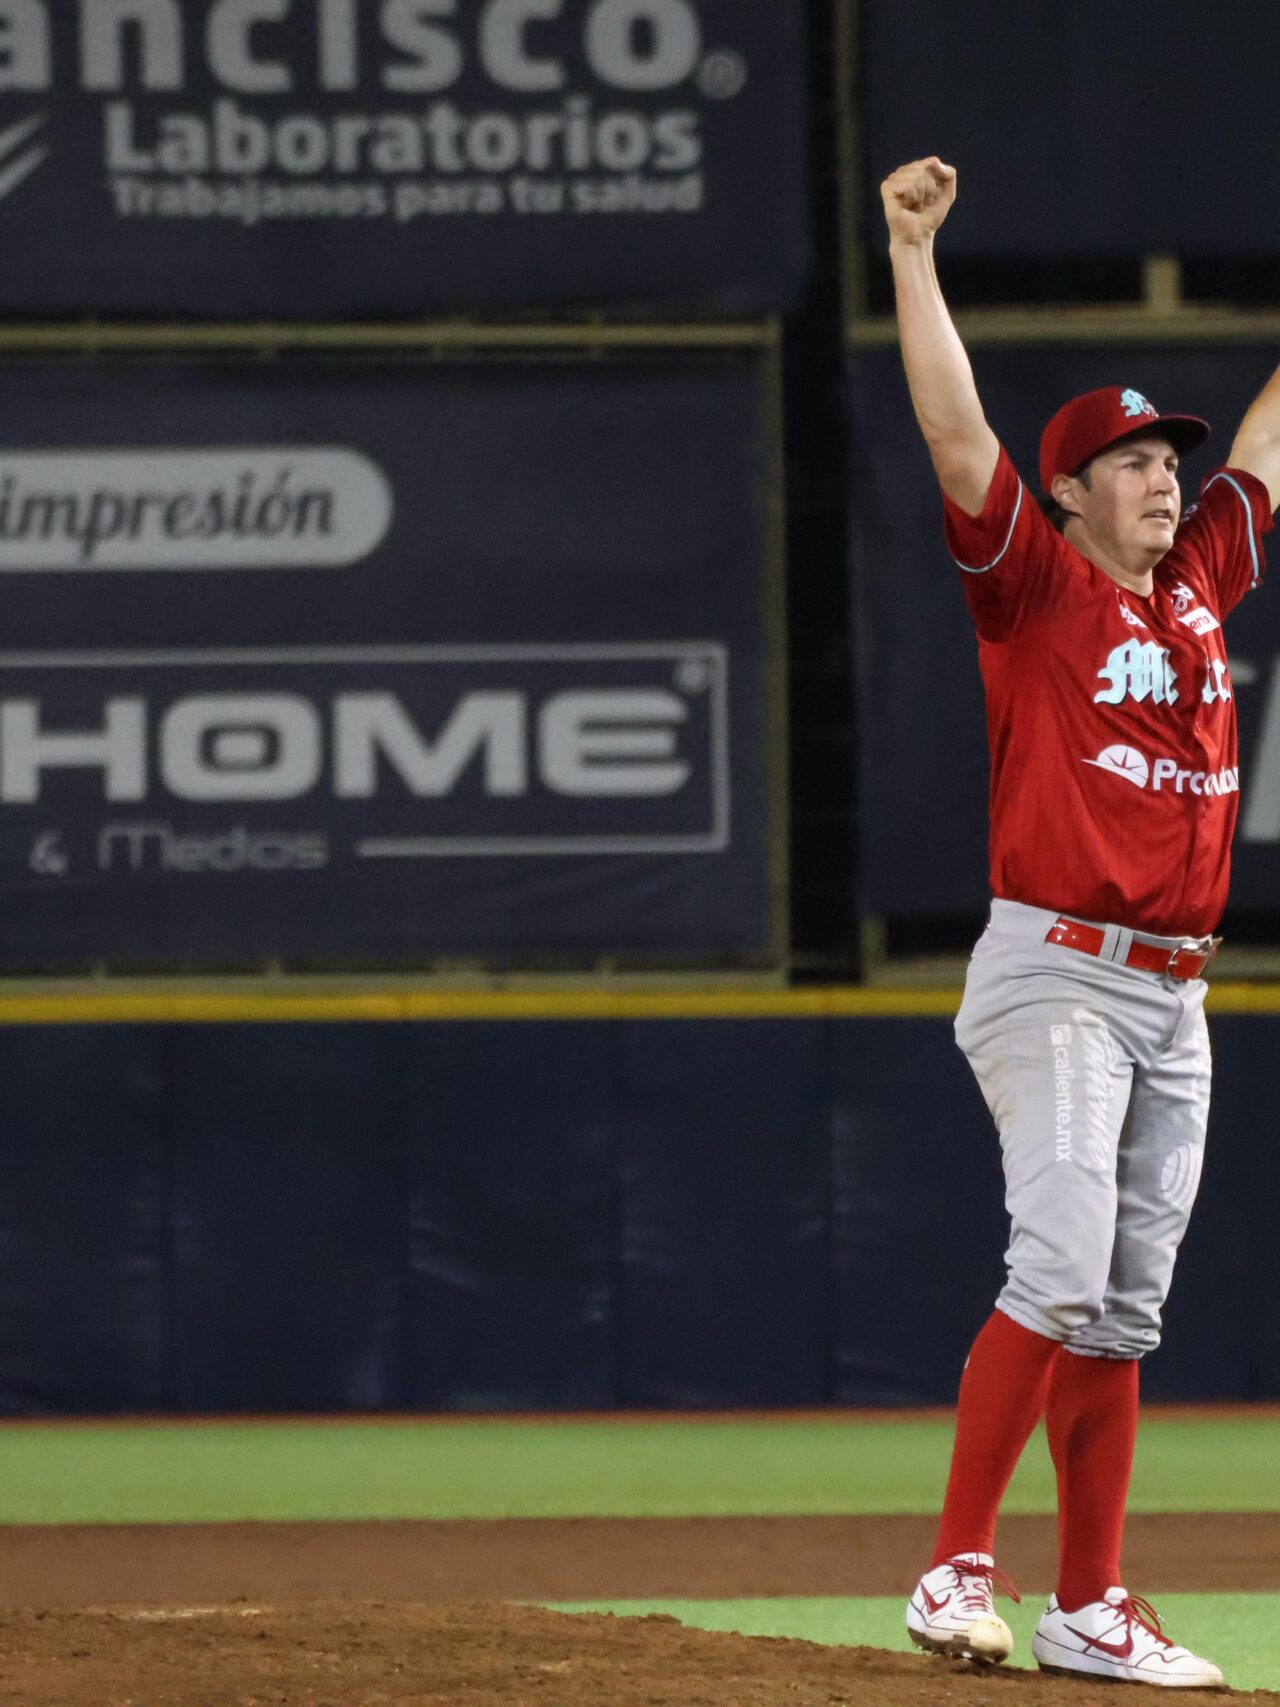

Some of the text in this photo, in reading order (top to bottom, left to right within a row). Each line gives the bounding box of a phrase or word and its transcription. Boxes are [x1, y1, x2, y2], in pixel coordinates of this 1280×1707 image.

[105, 97, 703, 174] Laboratorios
[110, 173, 704, 226] Trabajamos para tu salud
[0, 467, 336, 559] impresión
[1, 689, 692, 802] HOME
[29, 830, 68, 875] &
